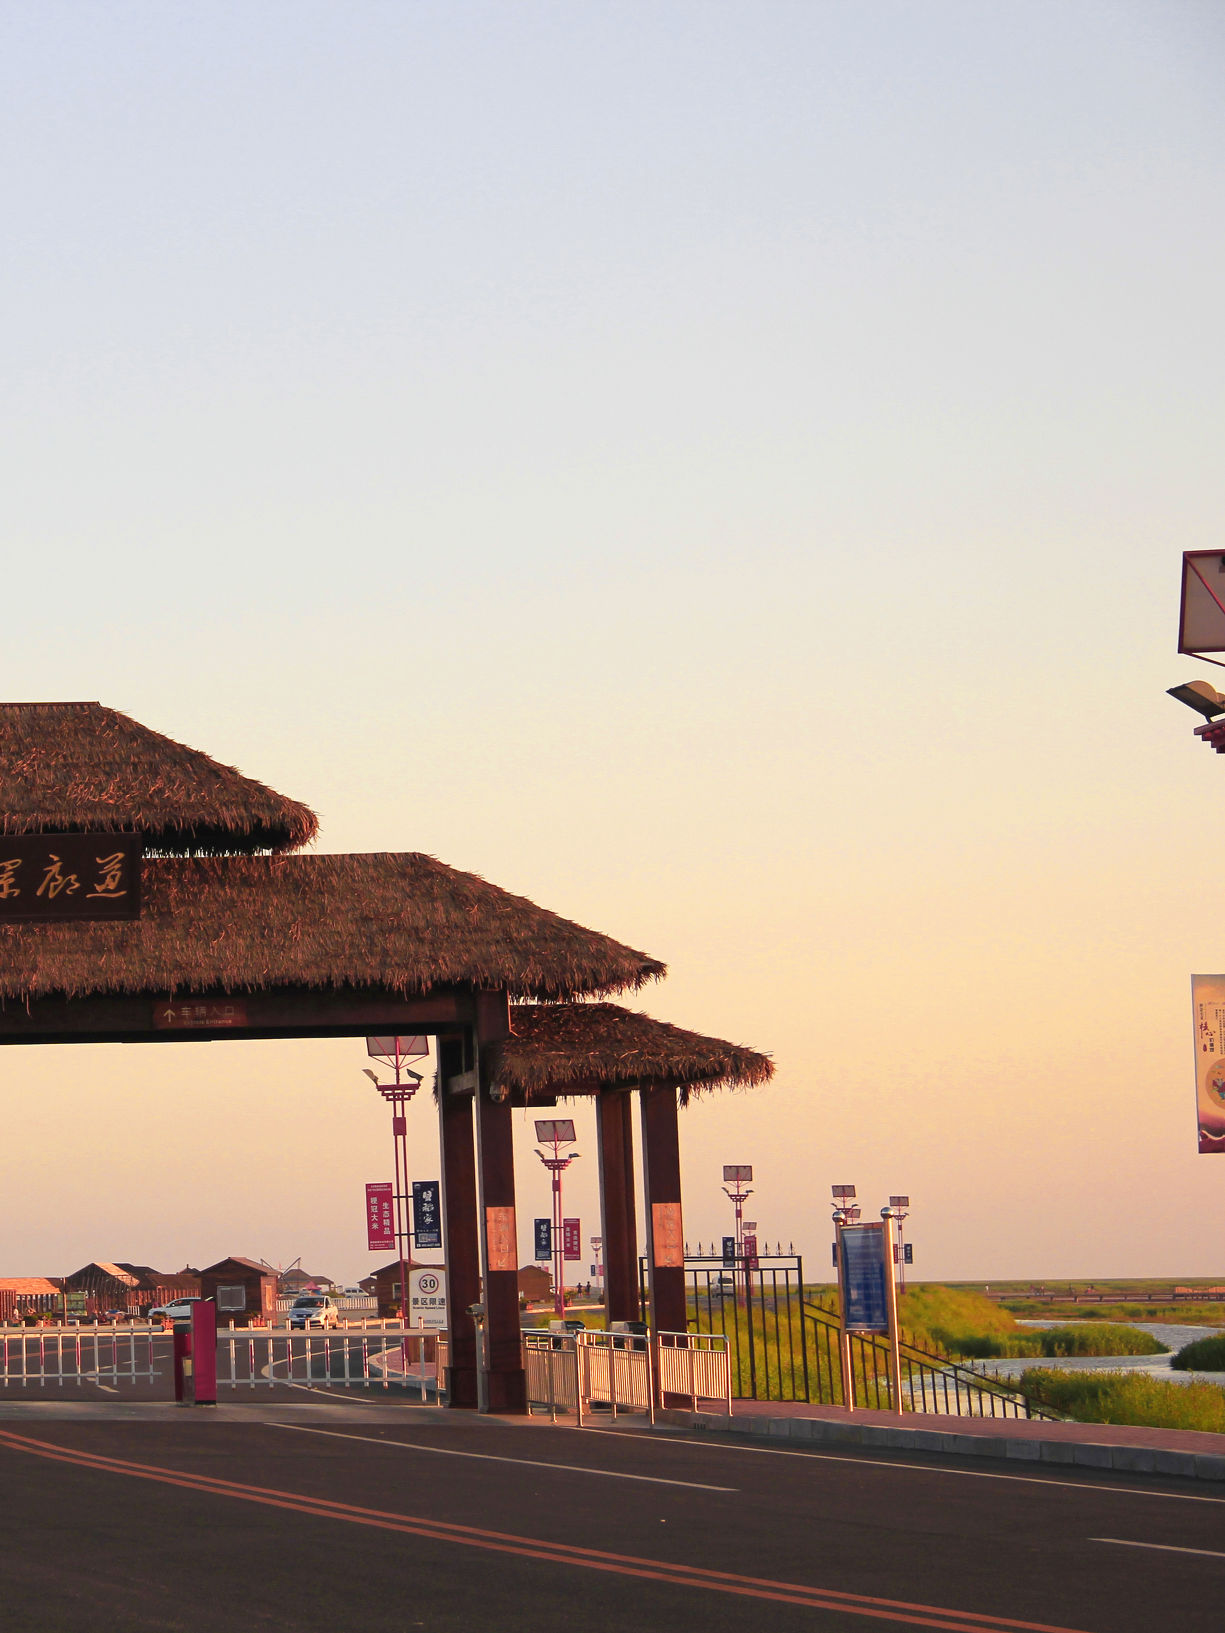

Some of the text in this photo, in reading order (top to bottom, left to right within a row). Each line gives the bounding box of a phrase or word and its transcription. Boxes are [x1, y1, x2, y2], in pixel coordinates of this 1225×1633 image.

[181, 1006, 235, 1019] 车辆入口
[422, 1279, 436, 1289] 30
[412, 1298, 446, 1306] 景区限速
